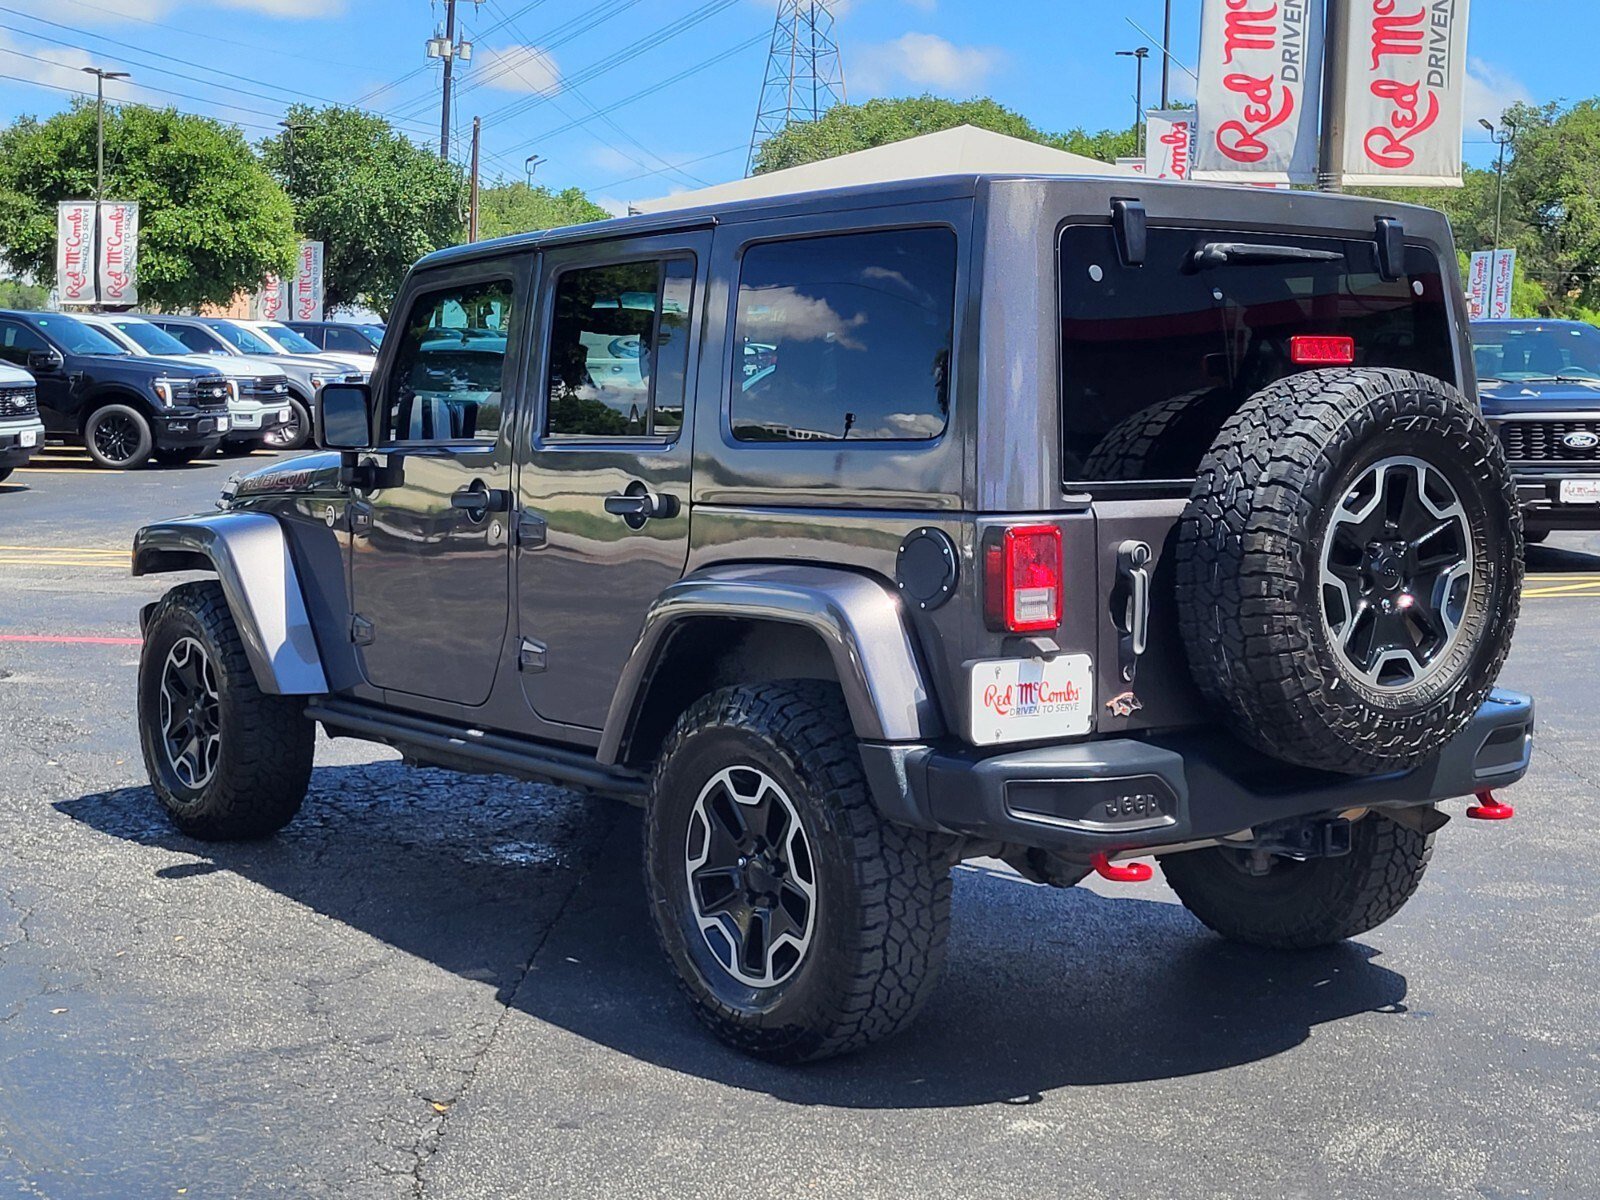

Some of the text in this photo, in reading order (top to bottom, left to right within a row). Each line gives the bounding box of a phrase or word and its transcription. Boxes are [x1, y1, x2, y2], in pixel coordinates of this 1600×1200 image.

[1216, 73, 1294, 163] Red
[1364, 79, 1439, 169] Red
[65, 208, 86, 299] Red McCombs
[106, 208, 128, 298] Red McCombs
[298, 297, 316, 320] Red
[984, 681, 1080, 715] Red McCombs
[1009, 702, 1080, 717] DRIVEN TO SERVE
[1105, 793, 1157, 818] Jeep
